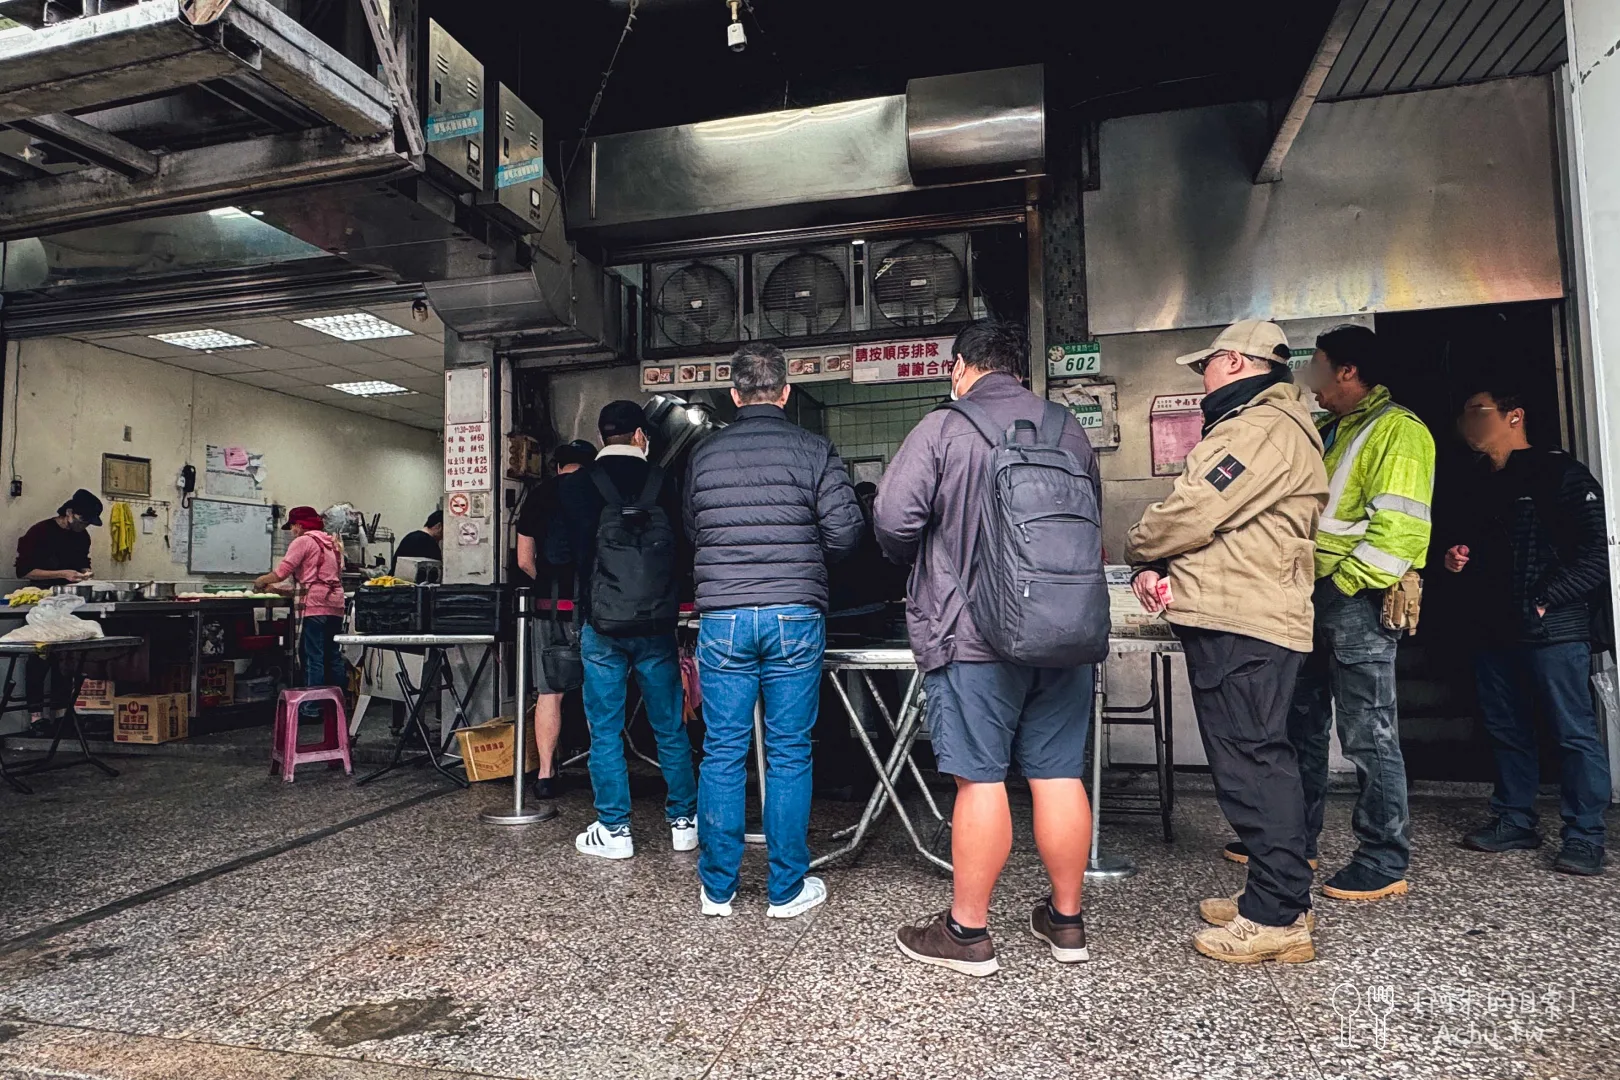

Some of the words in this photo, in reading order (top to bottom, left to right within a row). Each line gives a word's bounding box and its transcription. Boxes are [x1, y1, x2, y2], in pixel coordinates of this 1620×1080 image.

[855, 343, 940, 362] 請按順序排隊
[897, 360, 956, 377] 謝謝合作
[1065, 356, 1096, 371] 602
[451, 478, 484, 487] 星期一公休
